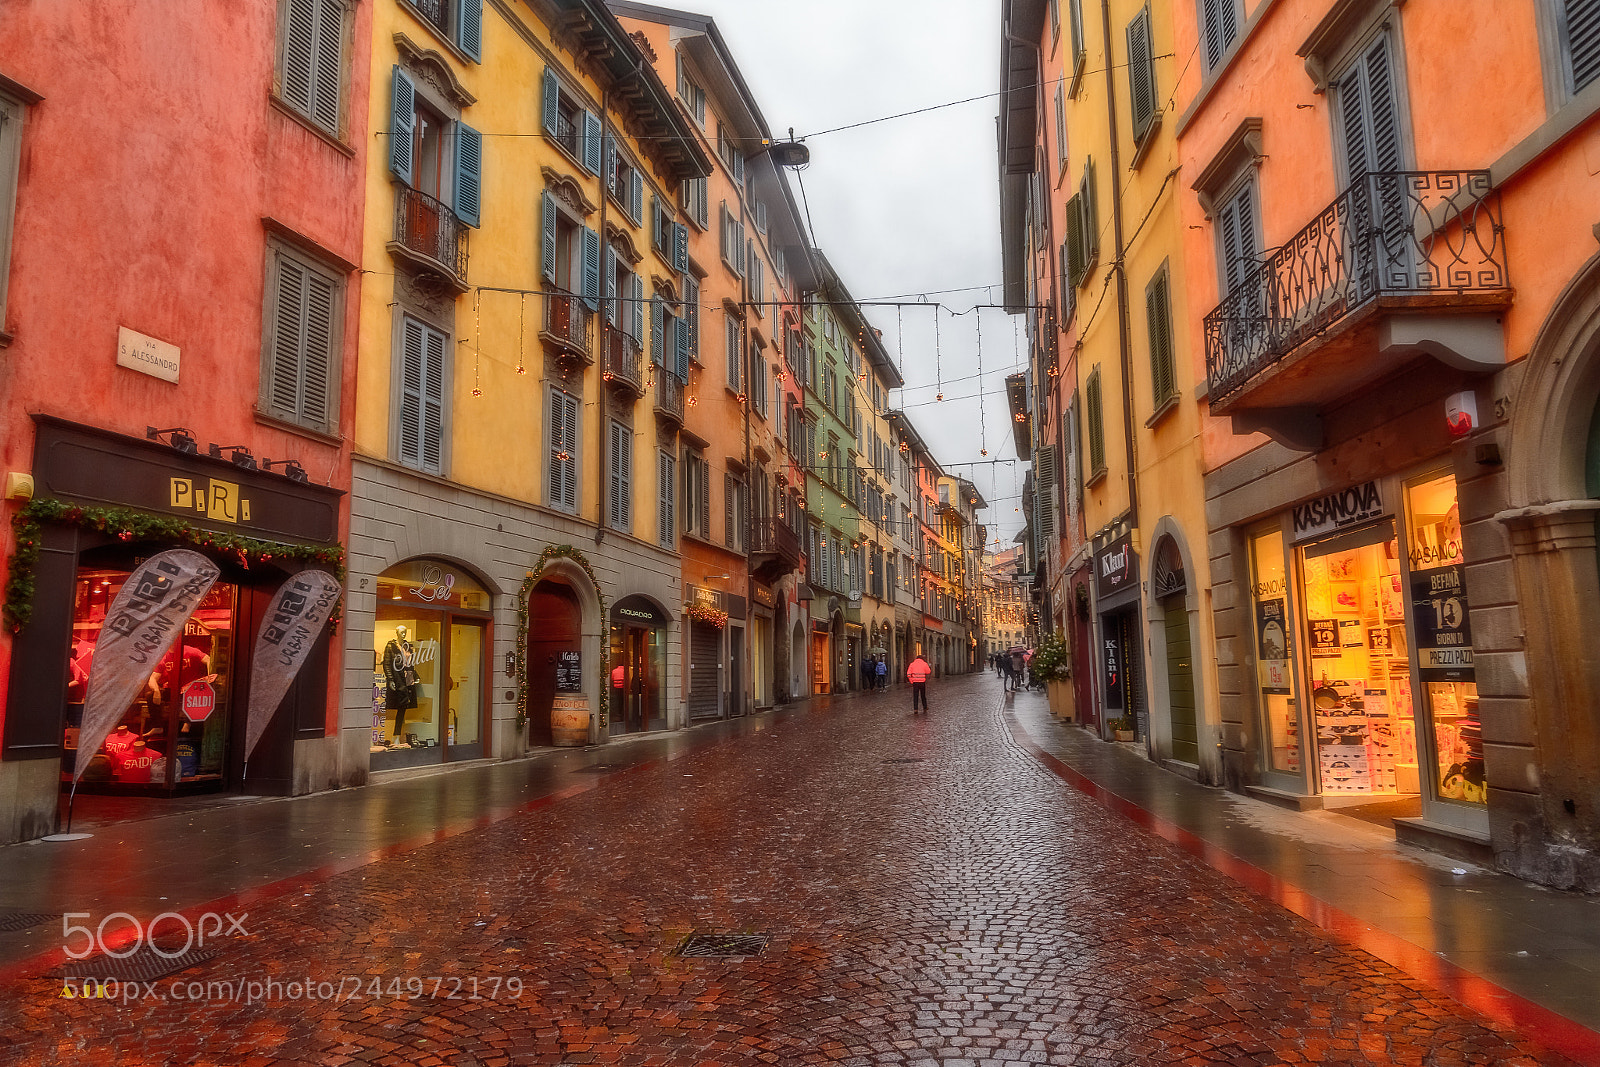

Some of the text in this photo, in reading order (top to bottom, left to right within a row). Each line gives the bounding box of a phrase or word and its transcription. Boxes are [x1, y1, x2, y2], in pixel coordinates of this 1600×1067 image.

[132, 349, 178, 372] ALESSANDRO
[145, 341, 156, 349] VIA
[1292, 481, 1382, 532] KASANOVA
[169, 567, 217, 613] STORE
[304, 584, 338, 623] STORE
[128, 613, 175, 664] URBAN
[279, 625, 311, 666] URBAN
[393, 637, 437, 672] Saldi
[1429, 651, 1455, 665] PREZZI
[186, 696, 211, 708] SALDI
